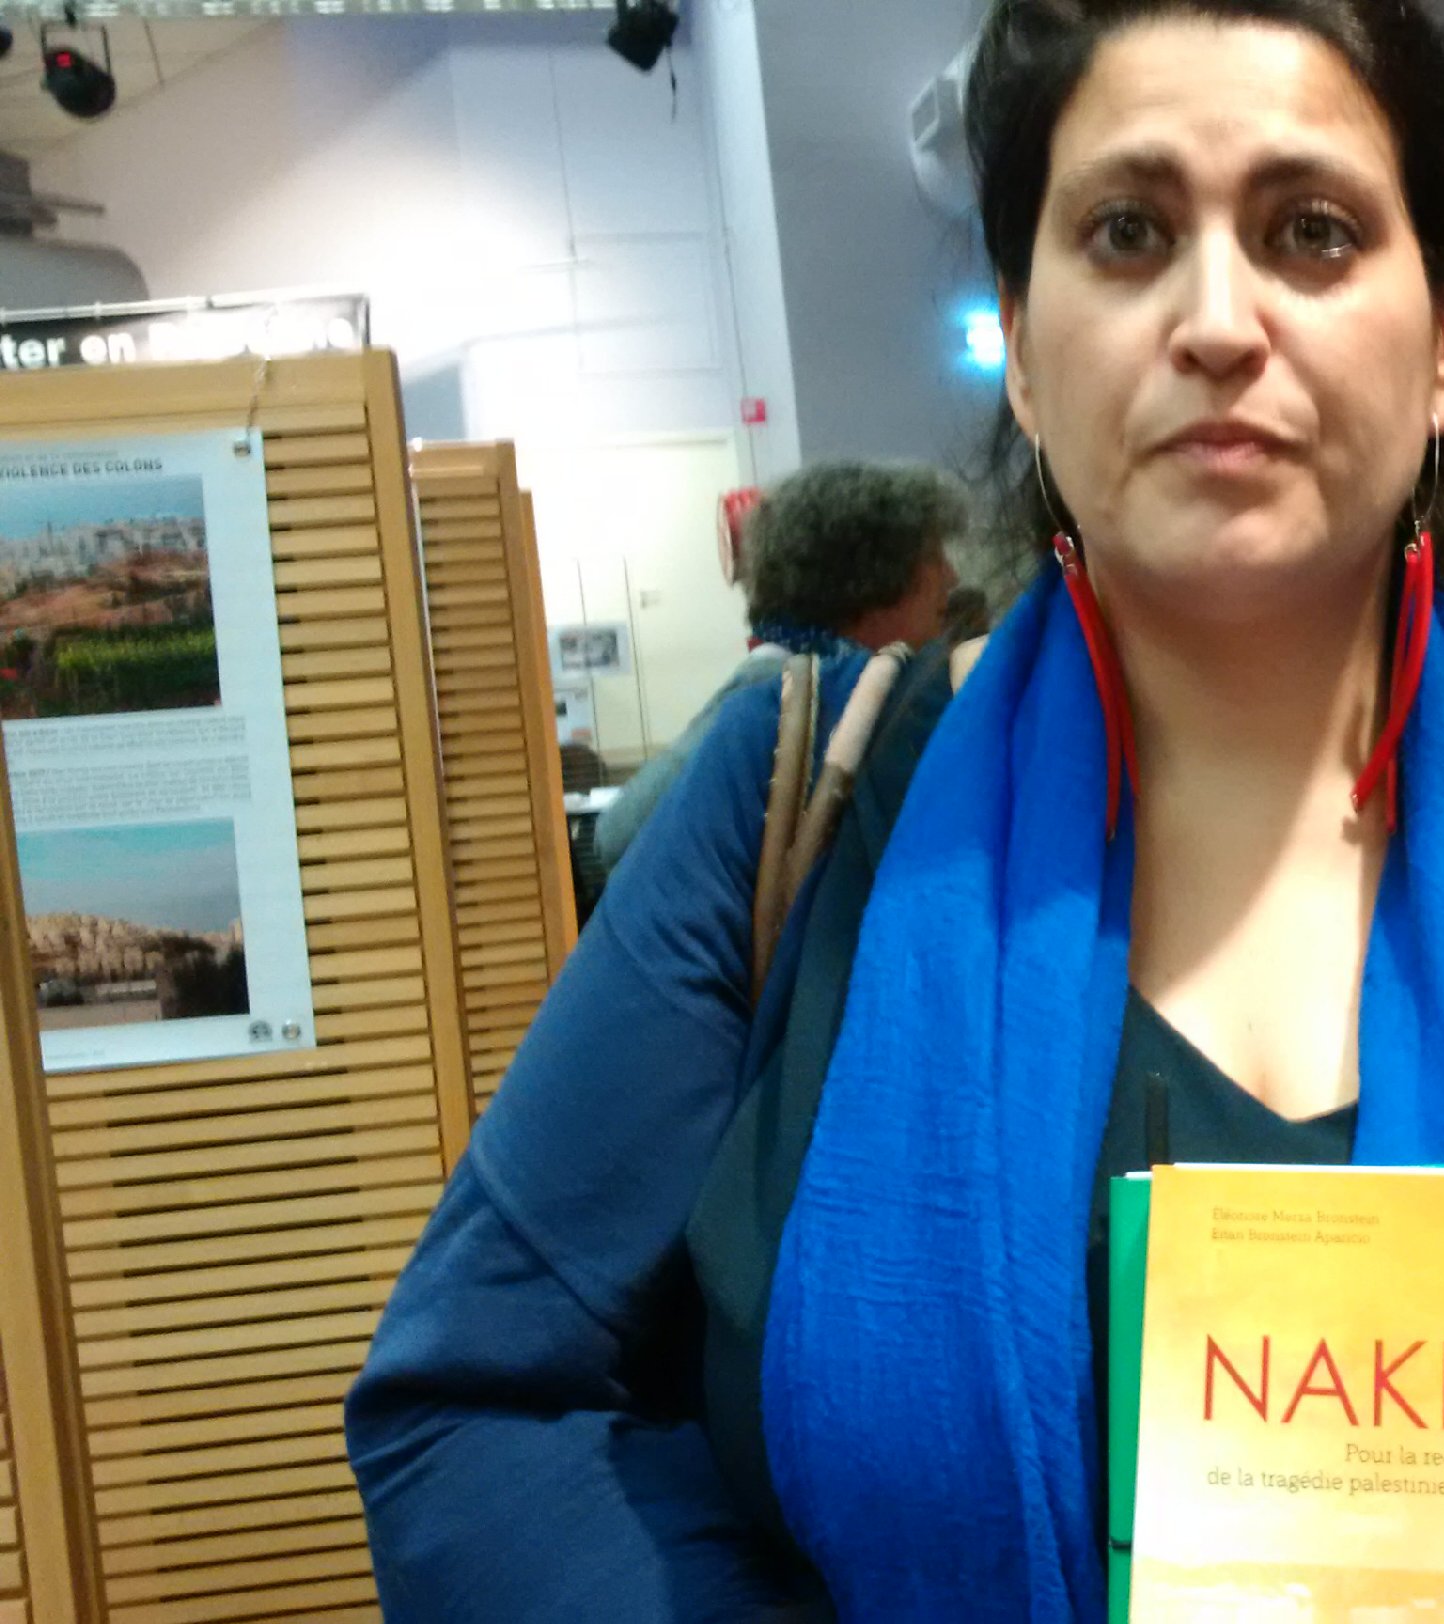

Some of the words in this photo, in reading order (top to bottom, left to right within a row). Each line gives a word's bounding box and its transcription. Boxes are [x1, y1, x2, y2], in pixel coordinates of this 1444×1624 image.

[79, 331, 136, 364] en
[73, 461, 101, 475] DES
[104, 458, 163, 472] COLONS
[1345, 1443, 1391, 1464] Pour
[1400, 1444, 1417, 1466] la
[1207, 1467, 1231, 1486] de
[1238, 1467, 1254, 1486] la
[1261, 1469, 1344, 1494] tragédie
